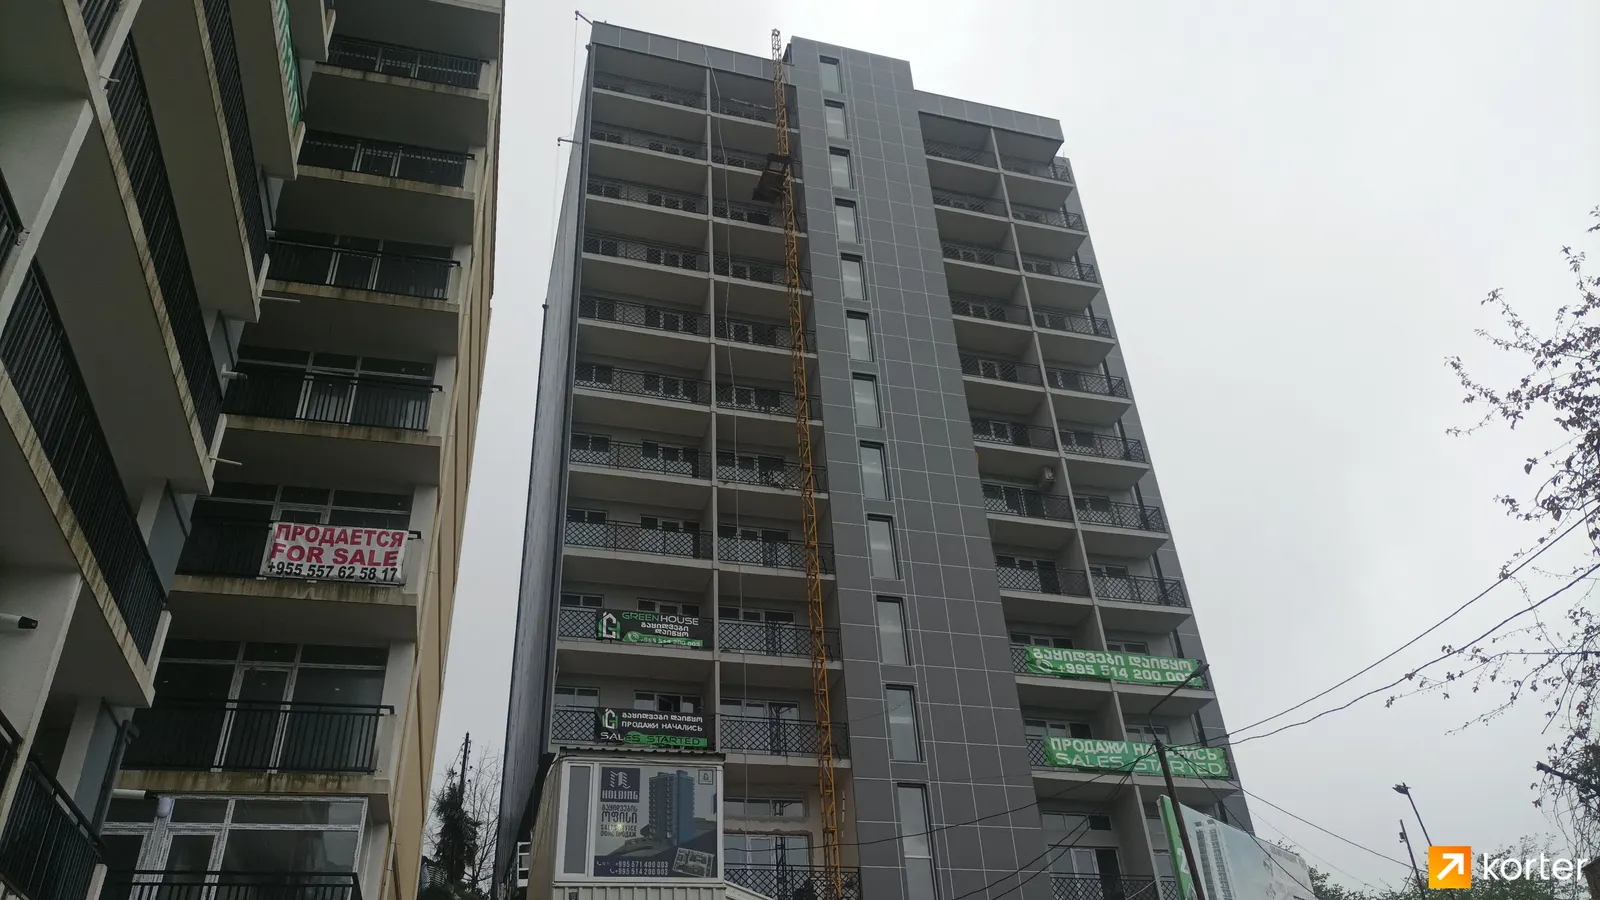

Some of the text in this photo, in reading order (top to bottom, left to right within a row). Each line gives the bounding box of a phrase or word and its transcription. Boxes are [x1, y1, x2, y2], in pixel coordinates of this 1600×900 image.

[275, 524, 404, 548] ПРОДАЕТСЯ
[270, 543, 399, 567] FOR SALE
[268, 561, 398, 582] +955 557 62 58 17
[1058, 663, 1095, 676] +995
[1101, 665, 1128, 678] 514
[1134, 670, 1161, 682] 200
[622, 721, 702, 732] ПРОДАЖИ НАЧАЛИСЬ
[601, 732, 700, 745] SALES STARTED
[1050, 738, 1217, 760] ПРОДАЖИ НААЛИСЬ
[1055, 753, 1124, 768] SALES
[602, 790, 638, 800] HOLDING
[601, 811, 637, 823] ოფისი
